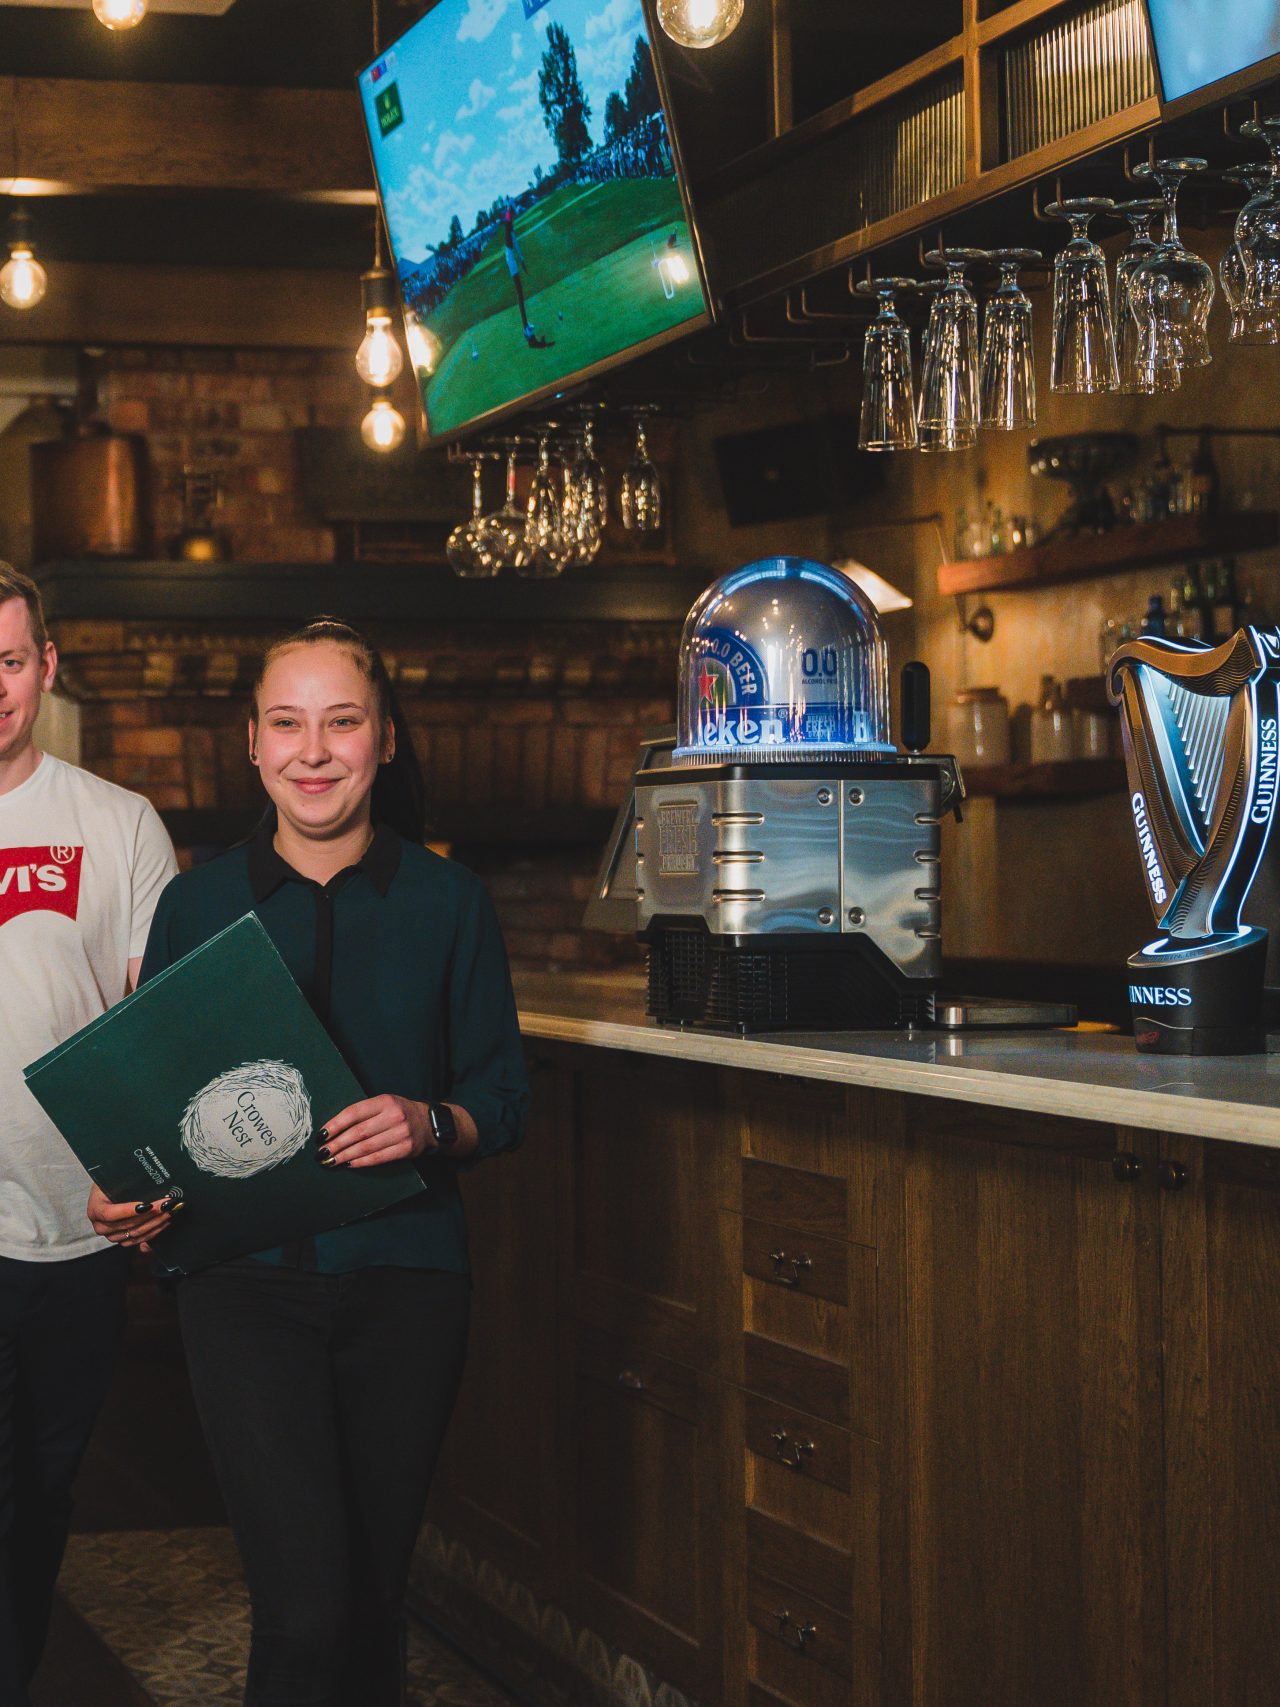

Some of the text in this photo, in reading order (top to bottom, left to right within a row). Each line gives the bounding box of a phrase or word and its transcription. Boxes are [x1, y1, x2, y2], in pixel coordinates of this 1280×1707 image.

[729, 650, 758, 696] BEER
[801, 647, 838, 677] 0.0
[1251, 718, 1277, 824] GUINNESS
[1132, 792, 1167, 904] GUINNESS
[222, 1110, 253, 1148] Nest
[237, 1091, 277, 1146] Crowes
